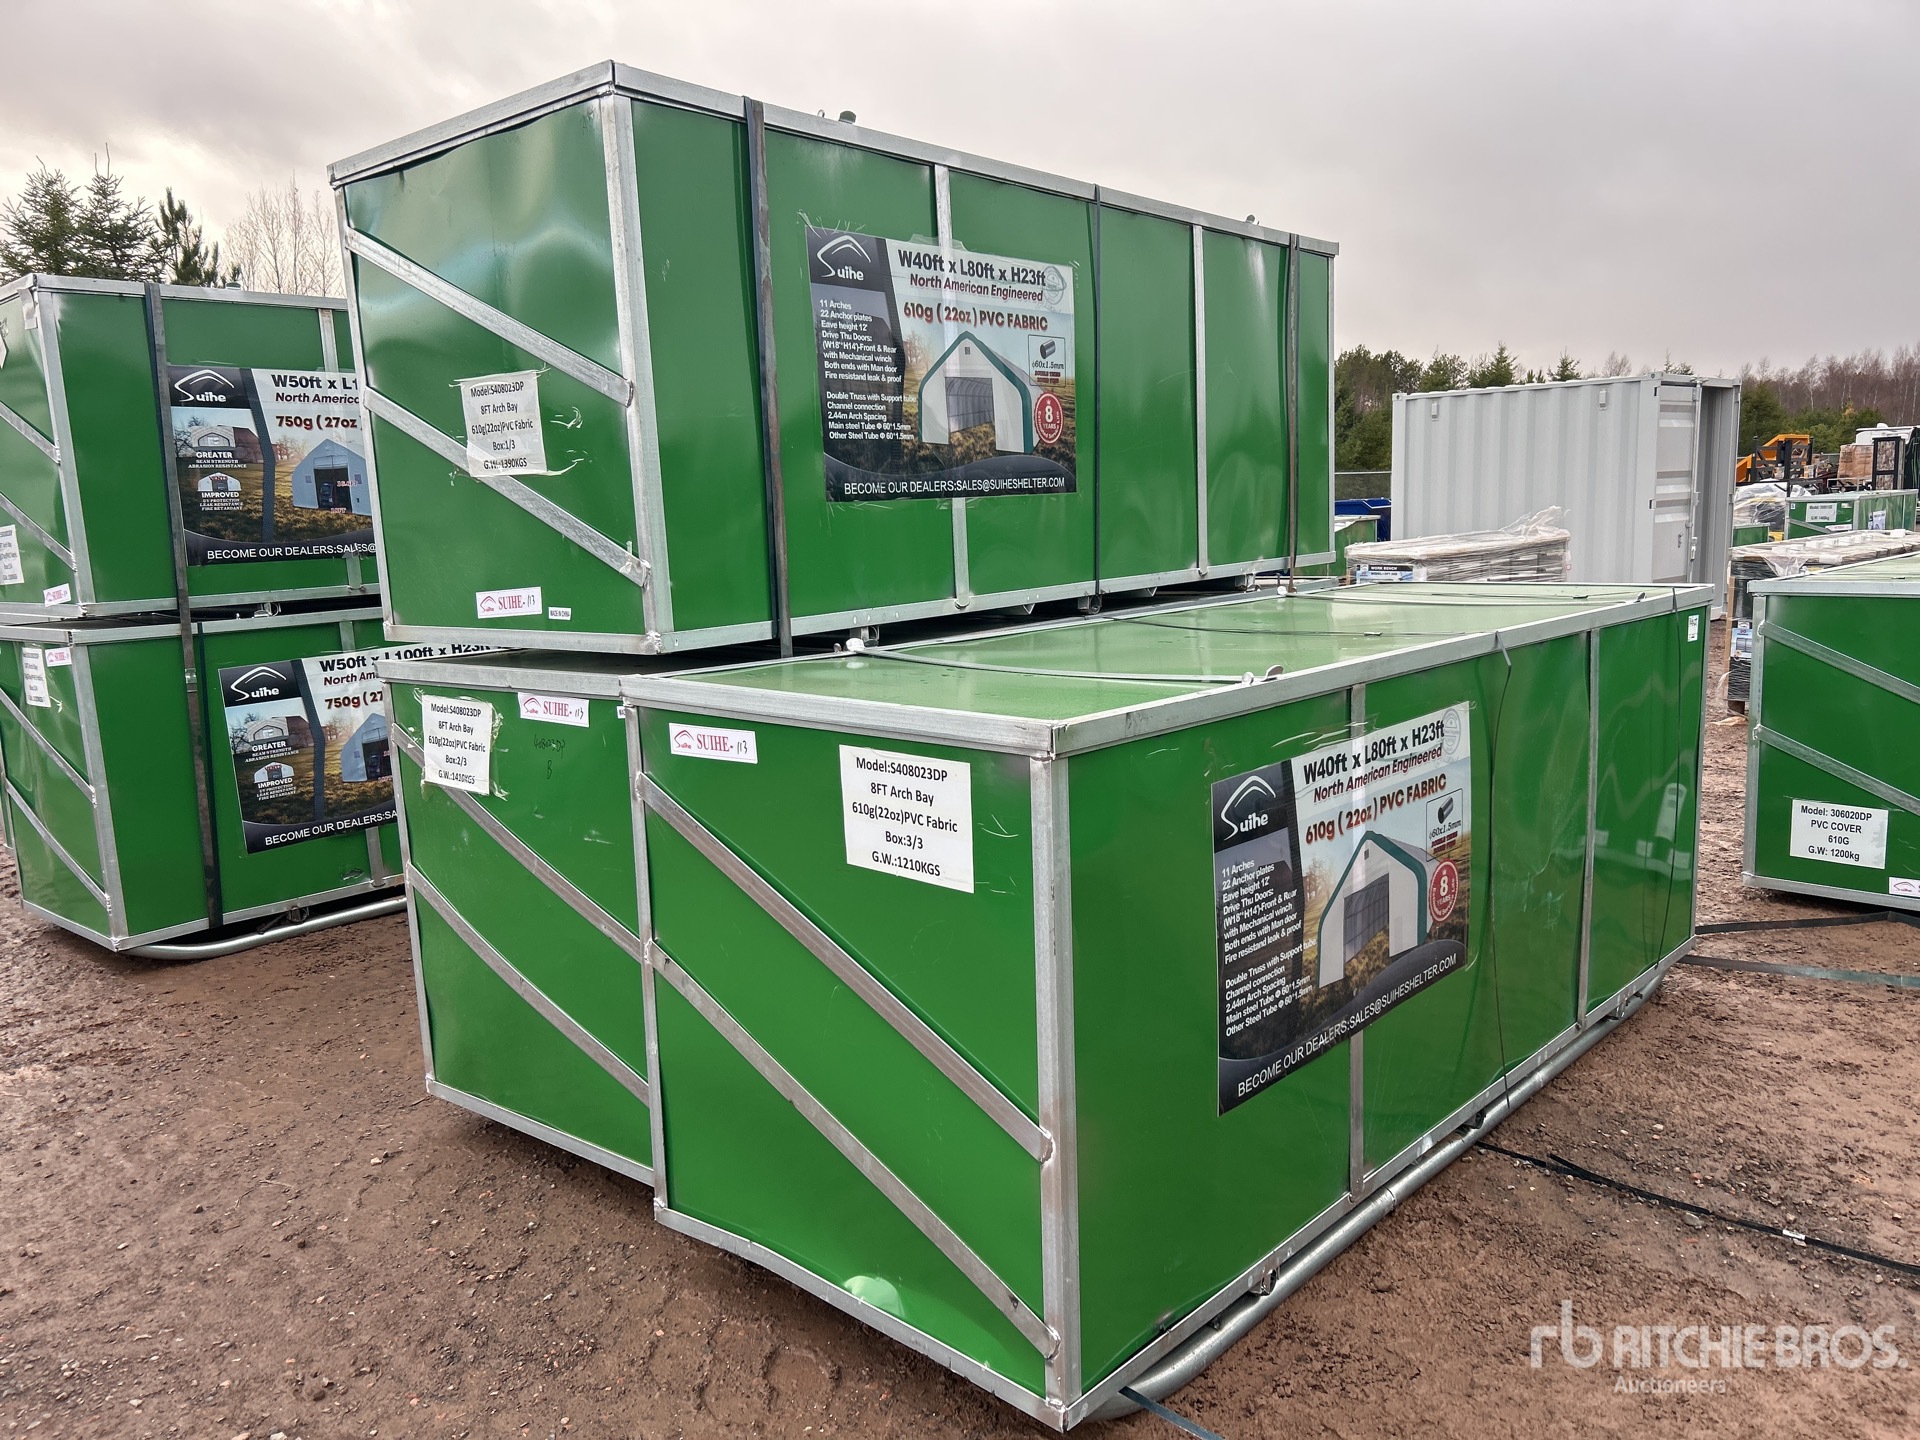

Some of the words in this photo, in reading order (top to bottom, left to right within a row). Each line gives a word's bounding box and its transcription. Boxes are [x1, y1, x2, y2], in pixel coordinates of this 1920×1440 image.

[898, 250, 944, 272] W40ft
[949, 261, 956, 273] x
[960, 259, 994, 279] L80ft
[999, 268, 1006, 281] x
[1011, 267, 1046, 286] H23ft
[910, 274, 941, 289] North
[944, 278, 988, 295] American
[991, 285, 1043, 301] Engineered
[904, 302, 933, 323] 610g
[980, 310, 1005, 327] PVC
[1007, 313, 1048, 331] FABRIC
[174, 376, 229, 402] Suihe
[271, 375, 322, 388] W50ft
[328, 379, 337, 389] x
[276, 393, 309, 402] North
[481, 405, 490, 415] 8FT
[493, 403, 505, 413] Arch
[507, 402, 518, 413] Bay
[1045, 405, 1053, 422] 8
[276, 416, 312, 430] 750g
[515, 419, 533, 429] Fabric
[493, 439, 515, 451] Box:1/3
[844, 482, 886, 495] BECOME
[888, 481, 908, 493] OUR
[207, 548, 256, 560] BECOME
[260, 547, 282, 558] OUR
[319, 656, 367, 672] W50ft
[439, 646, 447, 655] x
[231, 673, 283, 701] Suihe
[324, 672, 357, 685] North
[325, 694, 360, 709] 750g
[439, 721, 447, 729] 8FT
[449, 722, 461, 732] Arch
[463, 724, 473, 735] Bay
[252, 741, 286, 751] GREATER
[469, 742, 485, 752] Fabric
[1304, 753, 1347, 785] W40ft
[1352, 755, 1361, 769] x
[1365, 736, 1396, 764] L80ft
[1400, 736, 1408, 751] x
[1412, 720, 1444, 747] H23ft
[446, 755, 467, 767] Box:2/3
[856, 756, 948, 783] Model:S408023DP
[258, 778, 292, 788] IMPROVED
[1314, 779, 1343, 802] North
[1346, 764, 1390, 791] American
[1392, 745, 1442, 773] Engineered
[871, 782, 888, 797] 8FT
[890, 786, 913, 801] Arch
[916, 789, 934, 807] Bay
[852, 802, 924, 826] 610g(22oz)PVC
[926, 815, 958, 833] Fabric
[1221, 785, 1273, 840] Suihe
[1306, 820, 1335, 844] 610g
[1380, 789, 1404, 814] PVC
[1407, 774, 1446, 803] FABRIC
[1801, 805, 1828, 816] Model:
[1831, 809, 1872, 821] 306020DP
[265, 829, 310, 846] BECOME
[313, 822, 334, 836] OUR
[1811, 820, 1828, 829] PVC
[1831, 822, 1861, 833] COVER
[885, 830, 923, 850] Box:3/3
[1828, 835, 1849, 845] 610G
[872, 850, 940, 877] G.W.:1210KGS
[1831, 849, 1860, 862] 1200kg
[1222, 867, 1229, 877] 11
[1232, 860, 1254, 874] Arches
[1222, 880, 1230, 890] 22
[1232, 871, 1255, 885] Anchor
[1256, 864, 1274, 879] plates
[1223, 891, 1239, 902] Eave
[1240, 882, 1260, 895] height
[1278, 895, 1282, 903] &
[1284, 889, 1297, 900] Rear
[1440, 875, 1448, 896] 8
[1223, 902, 1240, 915] Drive
[1241, 896, 1253, 907] Thu
[1224, 927, 1238, 940] with
[1240, 910, 1274, 933] Mechanical
[1275, 902, 1292, 916] winch
[1225, 940, 1239, 952] Both
[1241, 932, 1256, 944] ends
[1257, 925, 1270, 937] with
[1271, 919, 1283, 930] Man
[1285, 912, 1297, 924] door
[1225, 953, 1237, 964] Fire
[1238, 937, 1266, 958] resistand
[1267, 932, 1280, 944] leak
[1281, 928, 1285, 937] &
[1287, 920, 1301, 936] proof
[1226, 972, 1247, 989] Double
[1248, 963, 1265, 977] Truss
[1267, 956, 1279, 968] with
[1280, 944, 1302, 961] Support
[1226, 981, 1251, 1000] Channel
[1253, 965, 1285, 988] connection
[1226, 997, 1245, 1013] 2.44m
[1247, 989, 1261, 1003] Arch
[1263, 977, 1285, 994] Spacing
[1226, 1011, 1242, 1025] Main
[1243, 1001, 1258, 1016] steel
[1259, 994, 1274, 1007] Tube
[1226, 1022, 1244, 1036] Other
[1246, 1011, 1261, 1027] Steel
[1262, 1005, 1277, 1017] Tube
[1238, 1059, 1282, 1098] BECOME
[1283, 1046, 1304, 1069] OUR
